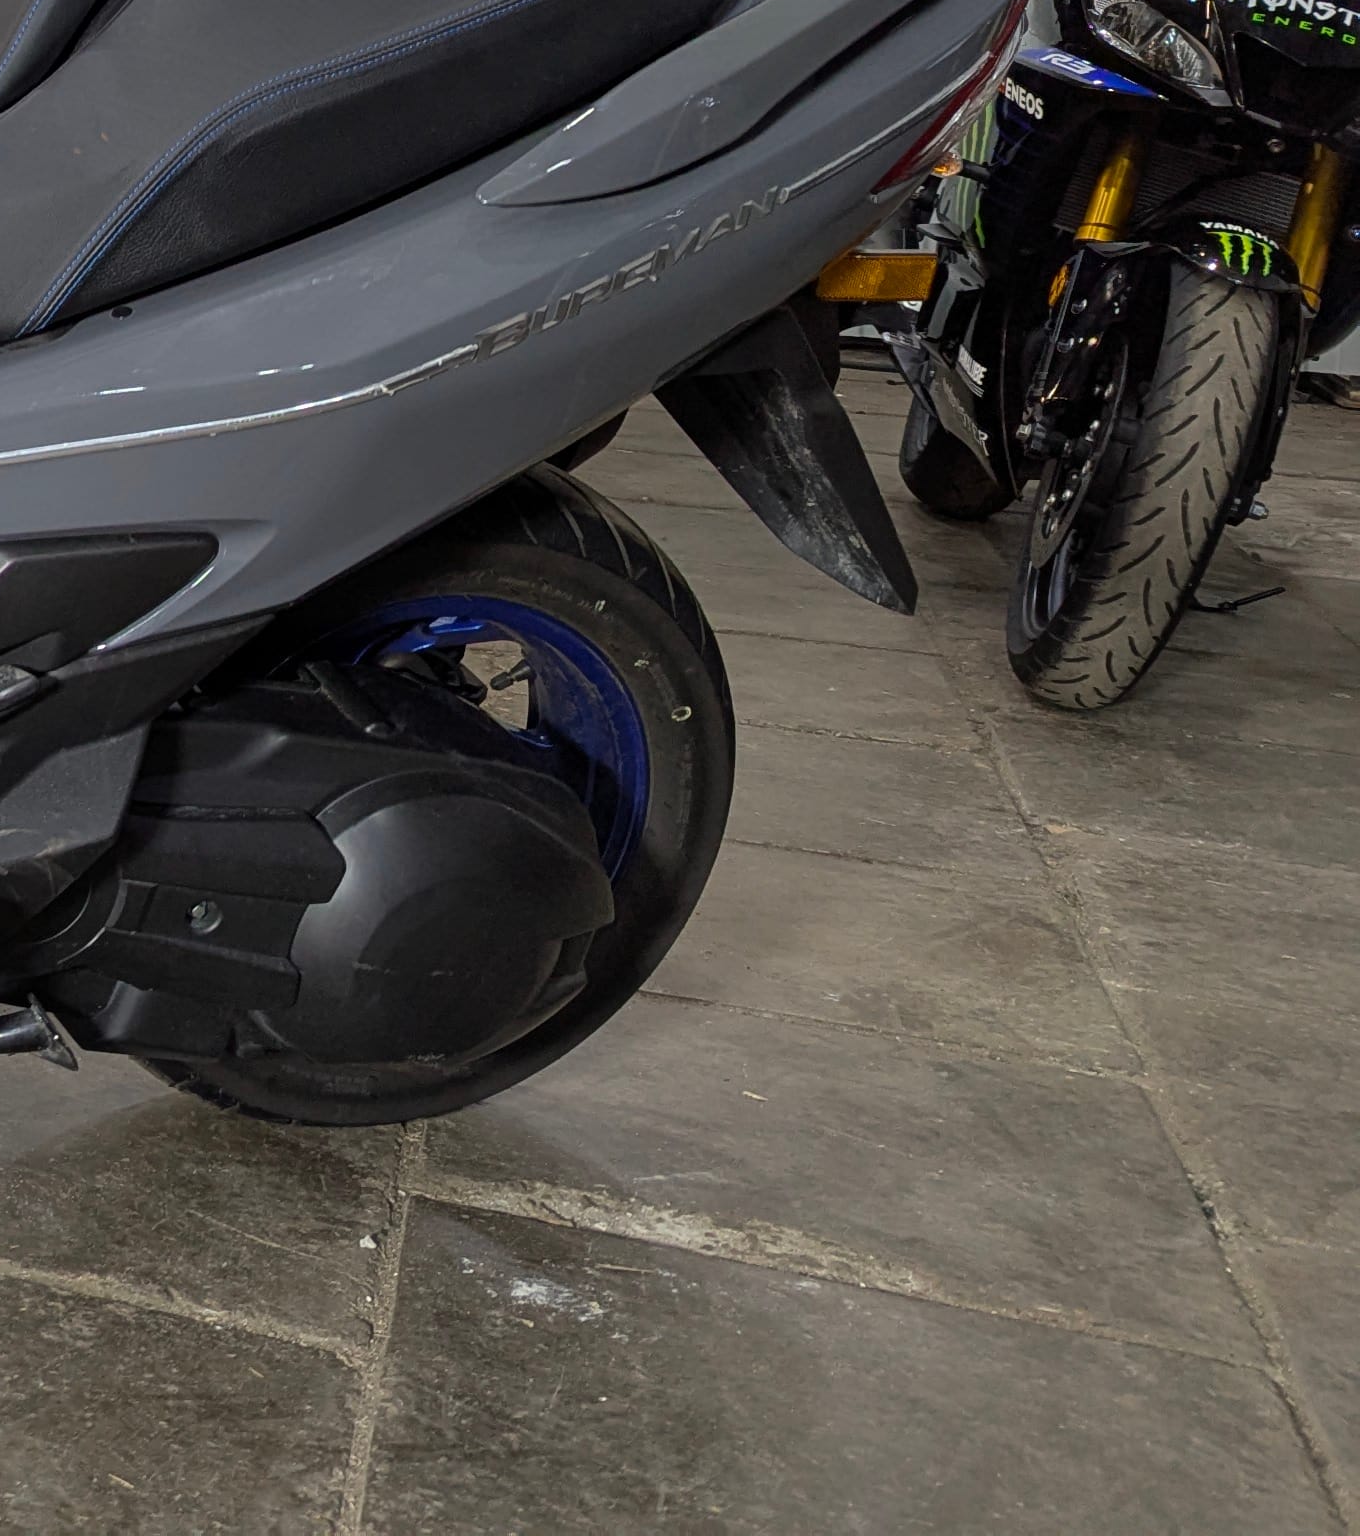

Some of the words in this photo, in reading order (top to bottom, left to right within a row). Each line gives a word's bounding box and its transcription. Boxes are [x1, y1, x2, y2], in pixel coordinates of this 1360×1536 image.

[1040, 53, 1097, 75] R3
[1004, 77, 1044, 120] ENEOS
[1198, 221, 1280, 250] YAMAHA
[474, 184, 784, 363] BURGMAN
